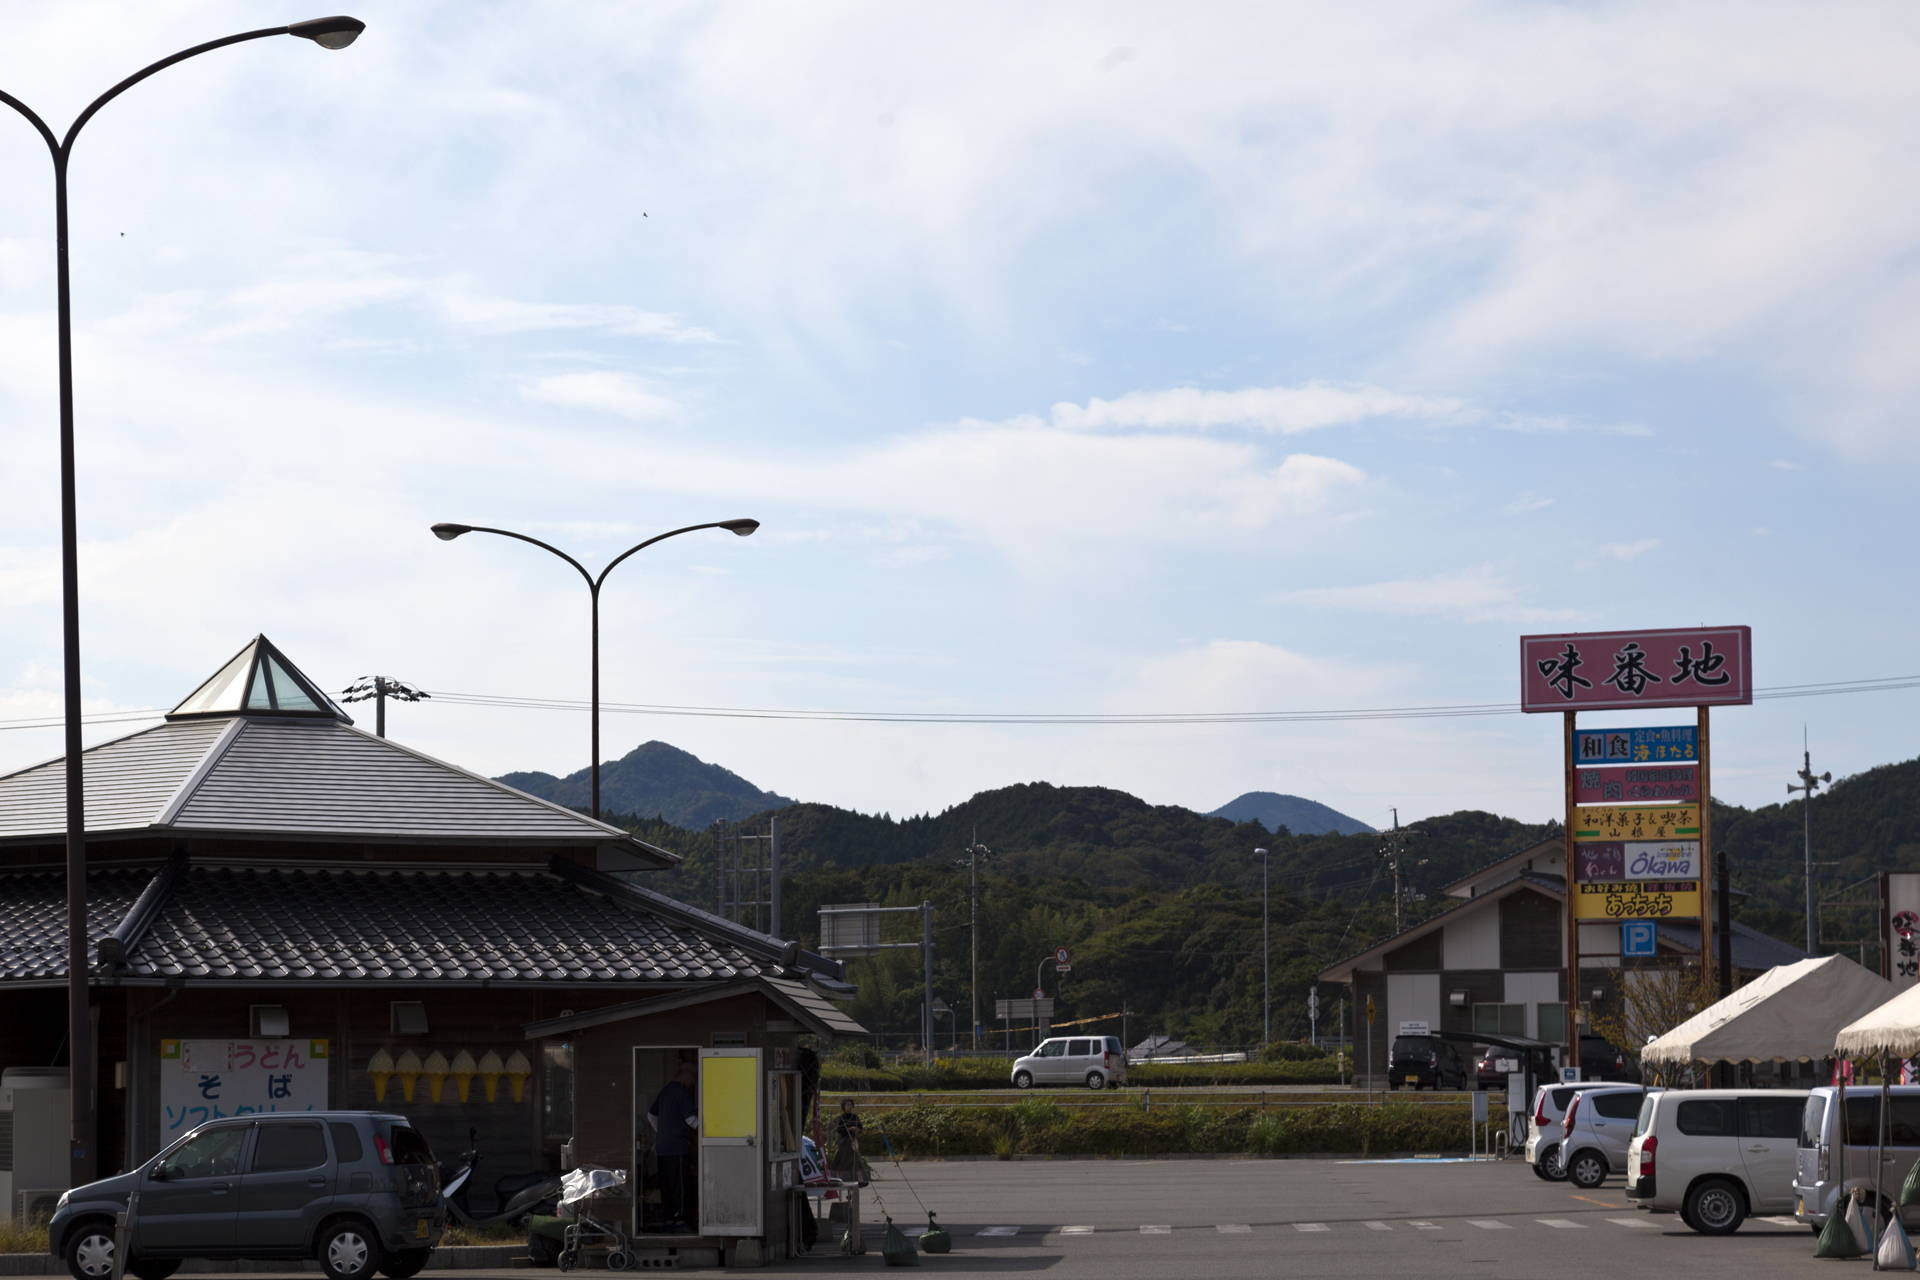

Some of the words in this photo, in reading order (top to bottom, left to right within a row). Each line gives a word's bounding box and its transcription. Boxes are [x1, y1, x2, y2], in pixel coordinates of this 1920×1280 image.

[1537, 640, 1731, 700] 味番地
[1581, 734, 1630, 759] 和食
[1633, 744, 1694, 762] 海ほたる
[1580, 769, 1623, 800] 焼肉
[1625, 767, 1694, 783] 韓国家庭料理
[1626, 784, 1693, 798] くらわんか
[1609, 826, 1666, 838] 山根屋
[1583, 883, 1638, 893] お好み焼
[1606, 893, 1673, 918] あっちっち
[1630, 927, 1650, 952] P
[197, 1074, 293, 1100] そば
